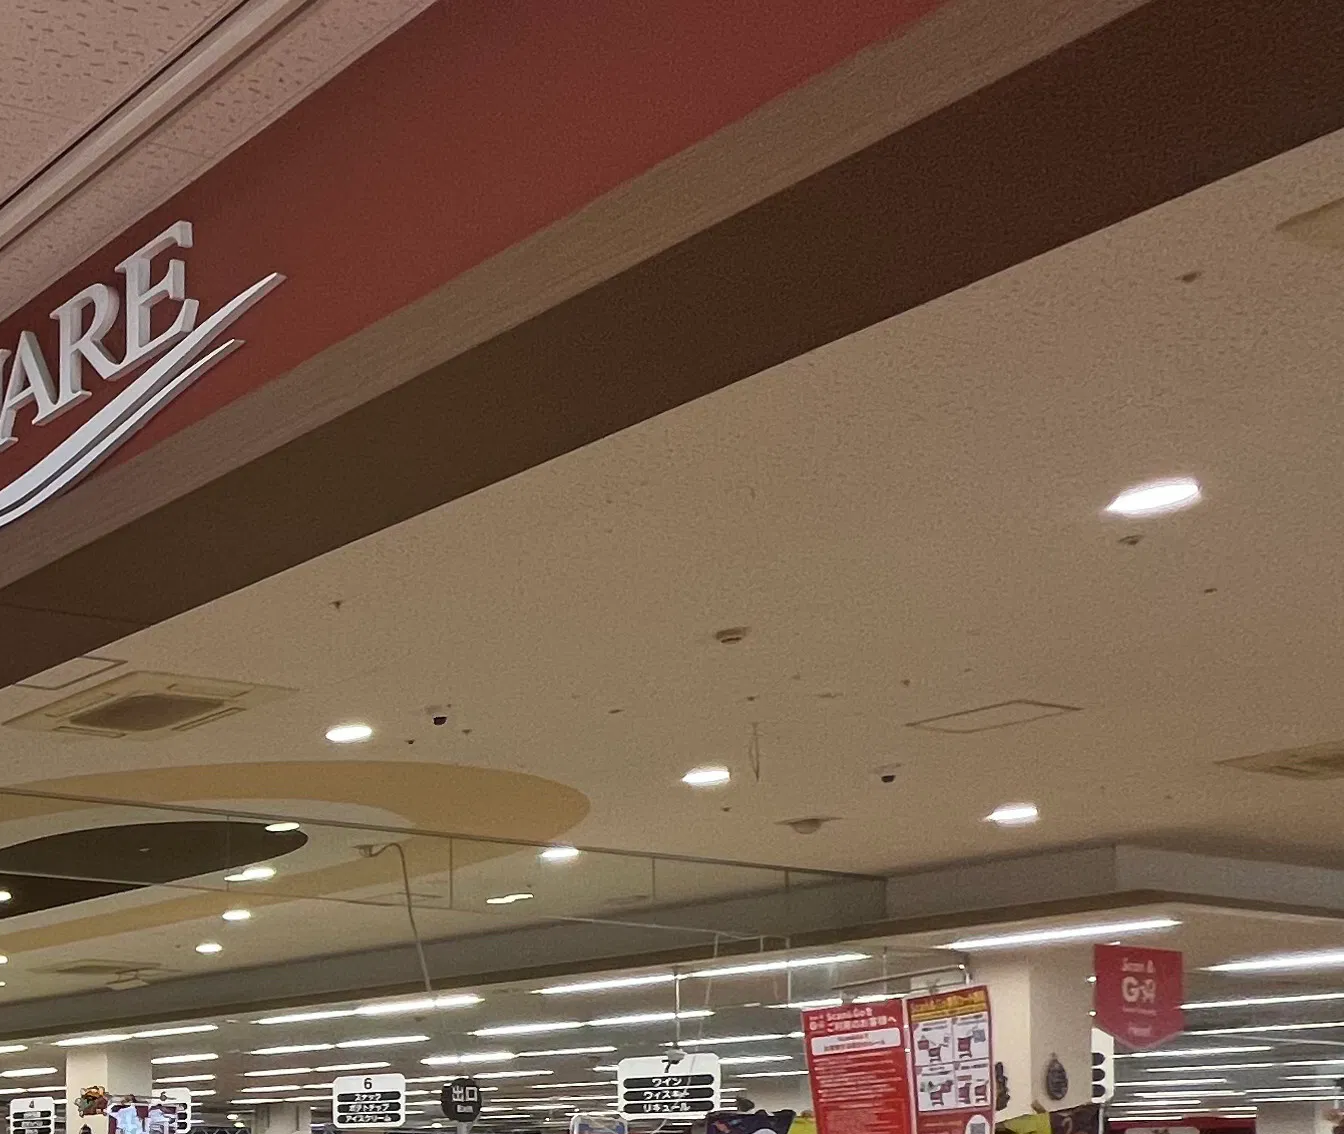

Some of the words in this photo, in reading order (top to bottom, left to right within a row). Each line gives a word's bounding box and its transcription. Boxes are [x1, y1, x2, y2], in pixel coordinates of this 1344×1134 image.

[363, 1078, 372, 1090] 6
[651, 1077, 682, 1087] ワイン
[451, 1086, 478, 1102] 出口
